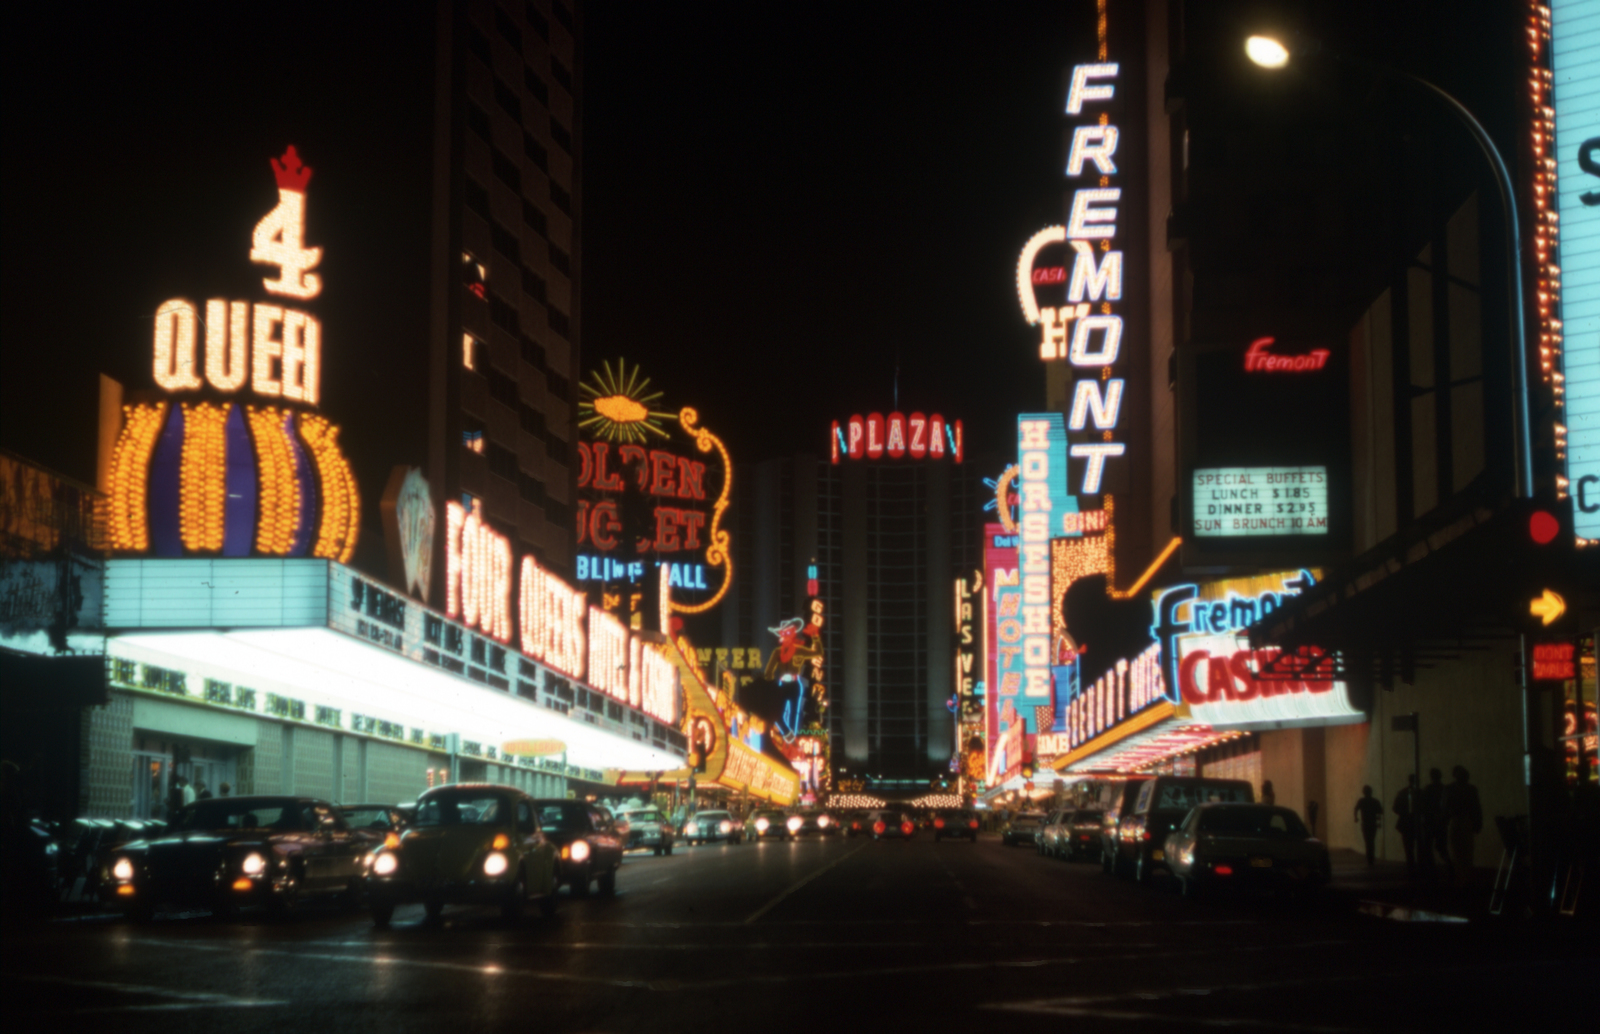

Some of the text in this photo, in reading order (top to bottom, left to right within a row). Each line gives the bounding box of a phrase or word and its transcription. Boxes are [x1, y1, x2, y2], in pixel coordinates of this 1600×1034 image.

[250, 188, 323, 299] 4
[1066, 62, 1126, 494] FREMONT
[849, 418, 944, 453] PLAZA
[1197, 471, 1323, 486] SPECIAL BUFFETS
[1212, 488, 1258, 500] LUNCH
[1195, 516, 1326, 531] SUN BRUNCH 10 AM
[1208, 503, 1262, 515] DINNER
[446, 500, 512, 643] FOUR
[1020, 420, 1051, 697] HORSESHOE
[961, 578, 973, 644] LAS
